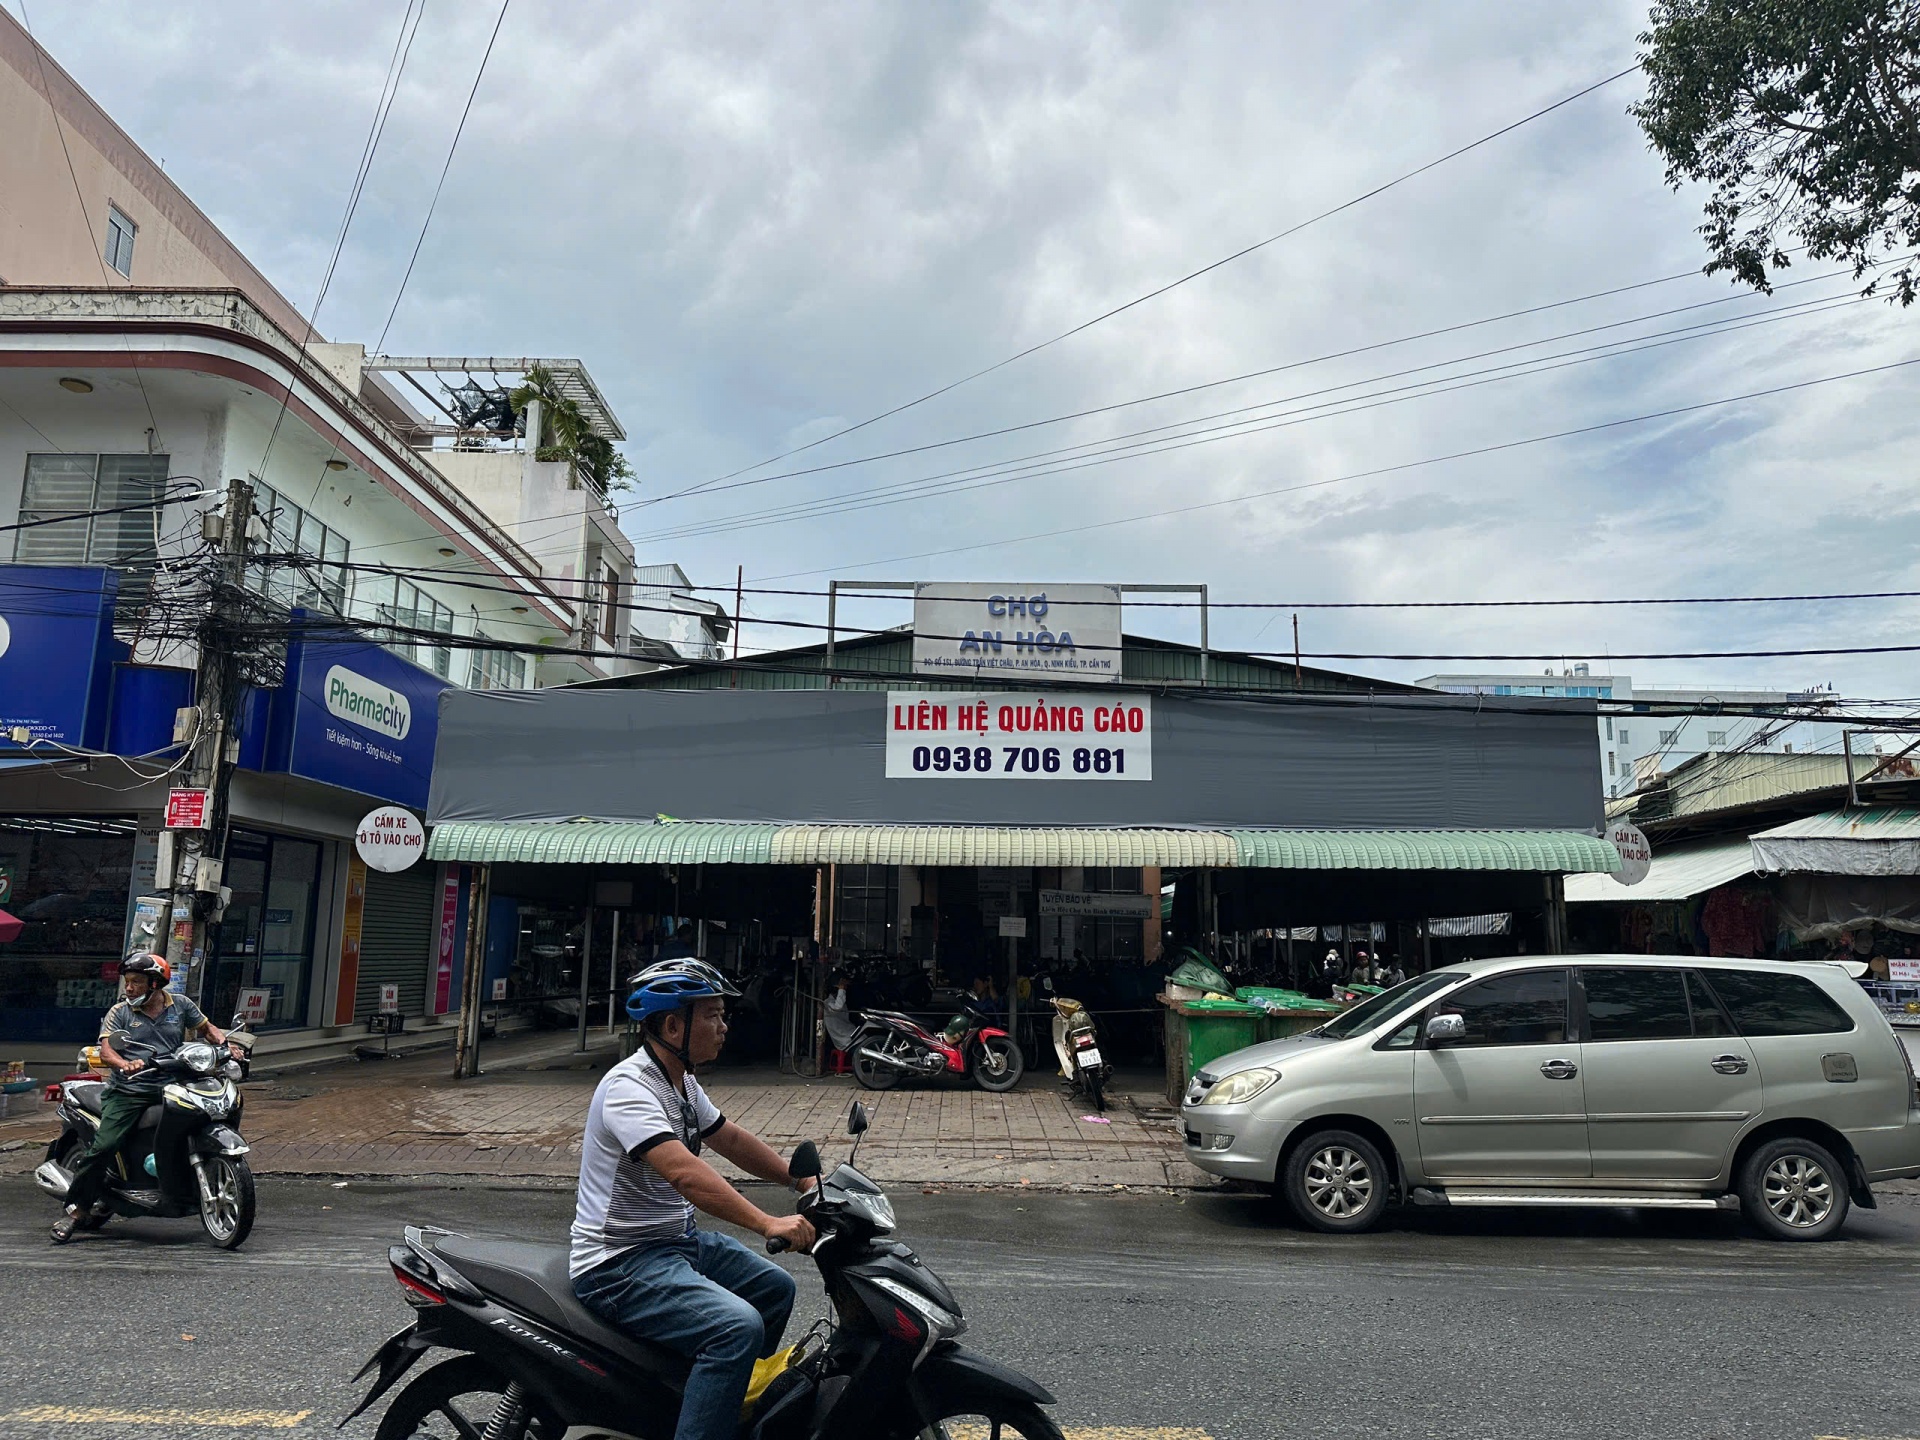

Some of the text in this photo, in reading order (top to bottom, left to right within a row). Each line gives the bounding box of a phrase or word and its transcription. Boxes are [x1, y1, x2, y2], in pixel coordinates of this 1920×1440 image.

[988, 592, 1048, 622] CHỢ
[959, 625, 1075, 652] AN HÒA
[1020, 660, 1029, 668] AN
[1051, 660, 1064, 668] NINH
[1080, 660, 1088, 668] TP.
[329, 677, 406, 737] Pharmacity
[894, 698, 1144, 736] LIÊN HỆ QUẢNG CÁO
[912, 746, 1125, 773] 0938 706 881
[375, 813, 407, 828] CẤM XE
[369, 831, 381, 844] TÔ
[383, 831, 401, 845] VÀO
[403, 834, 422, 849] CHỢ
[1615, 828, 1639, 845] CẤM XE
[1622, 846, 1635, 860] VÀO
[1636, 849, 1649, 864] CHỢ
[1042, 891, 1064, 903] TUYỂN
